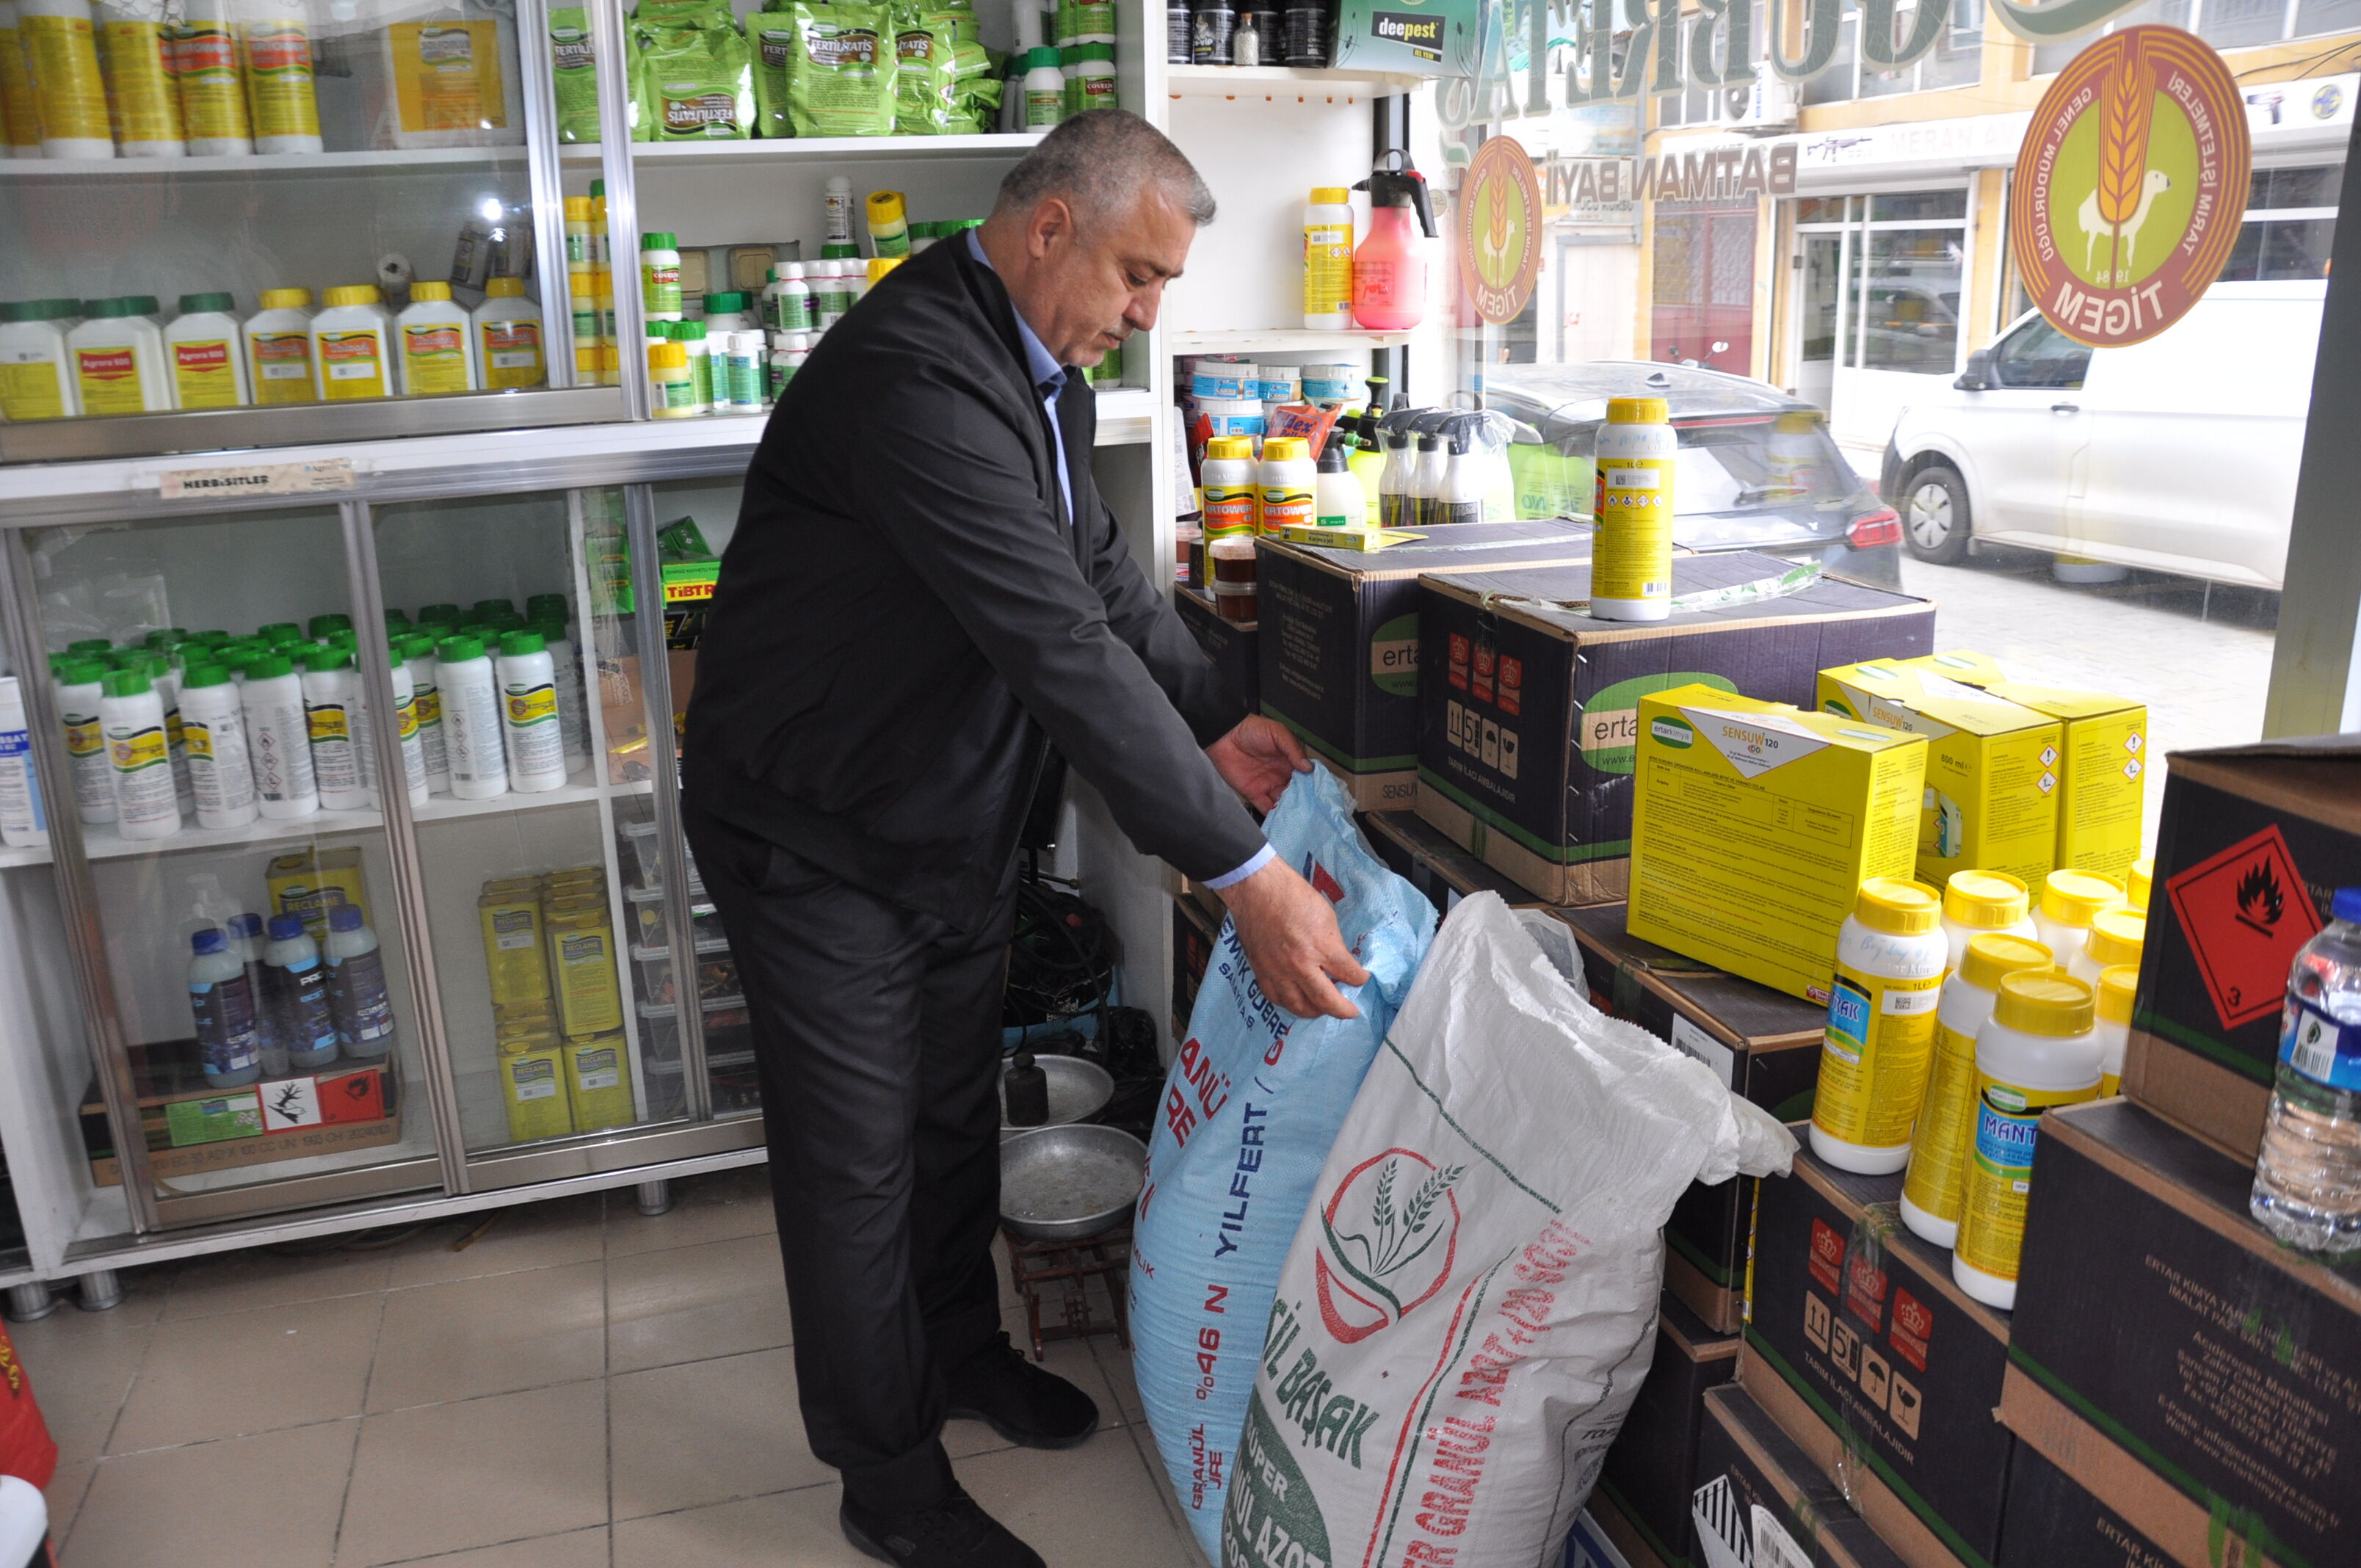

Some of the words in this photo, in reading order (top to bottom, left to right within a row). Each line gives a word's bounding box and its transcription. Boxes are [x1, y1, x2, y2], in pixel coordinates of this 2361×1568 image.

[1379, 19, 1436, 40] deepest
[1653, 724, 1690, 741] ertarkimya
[1765, 738, 1779, 749] 120
[1940, 753, 1954, 765] 800
[2228, 987, 2241, 1006] 3
[1214, 1102, 1268, 1258] YILFERT
[2145, 1254, 2181, 1285] ERTAR
[1203, 1284, 1229, 1314] N
[1195, 1327, 1222, 1402] %46
[1275, 1346, 1380, 1470] BAŞAK
[1414, 1415, 1498, 1537] GRANÜL
[2096, 1516, 2142, 1561] ERTAR
